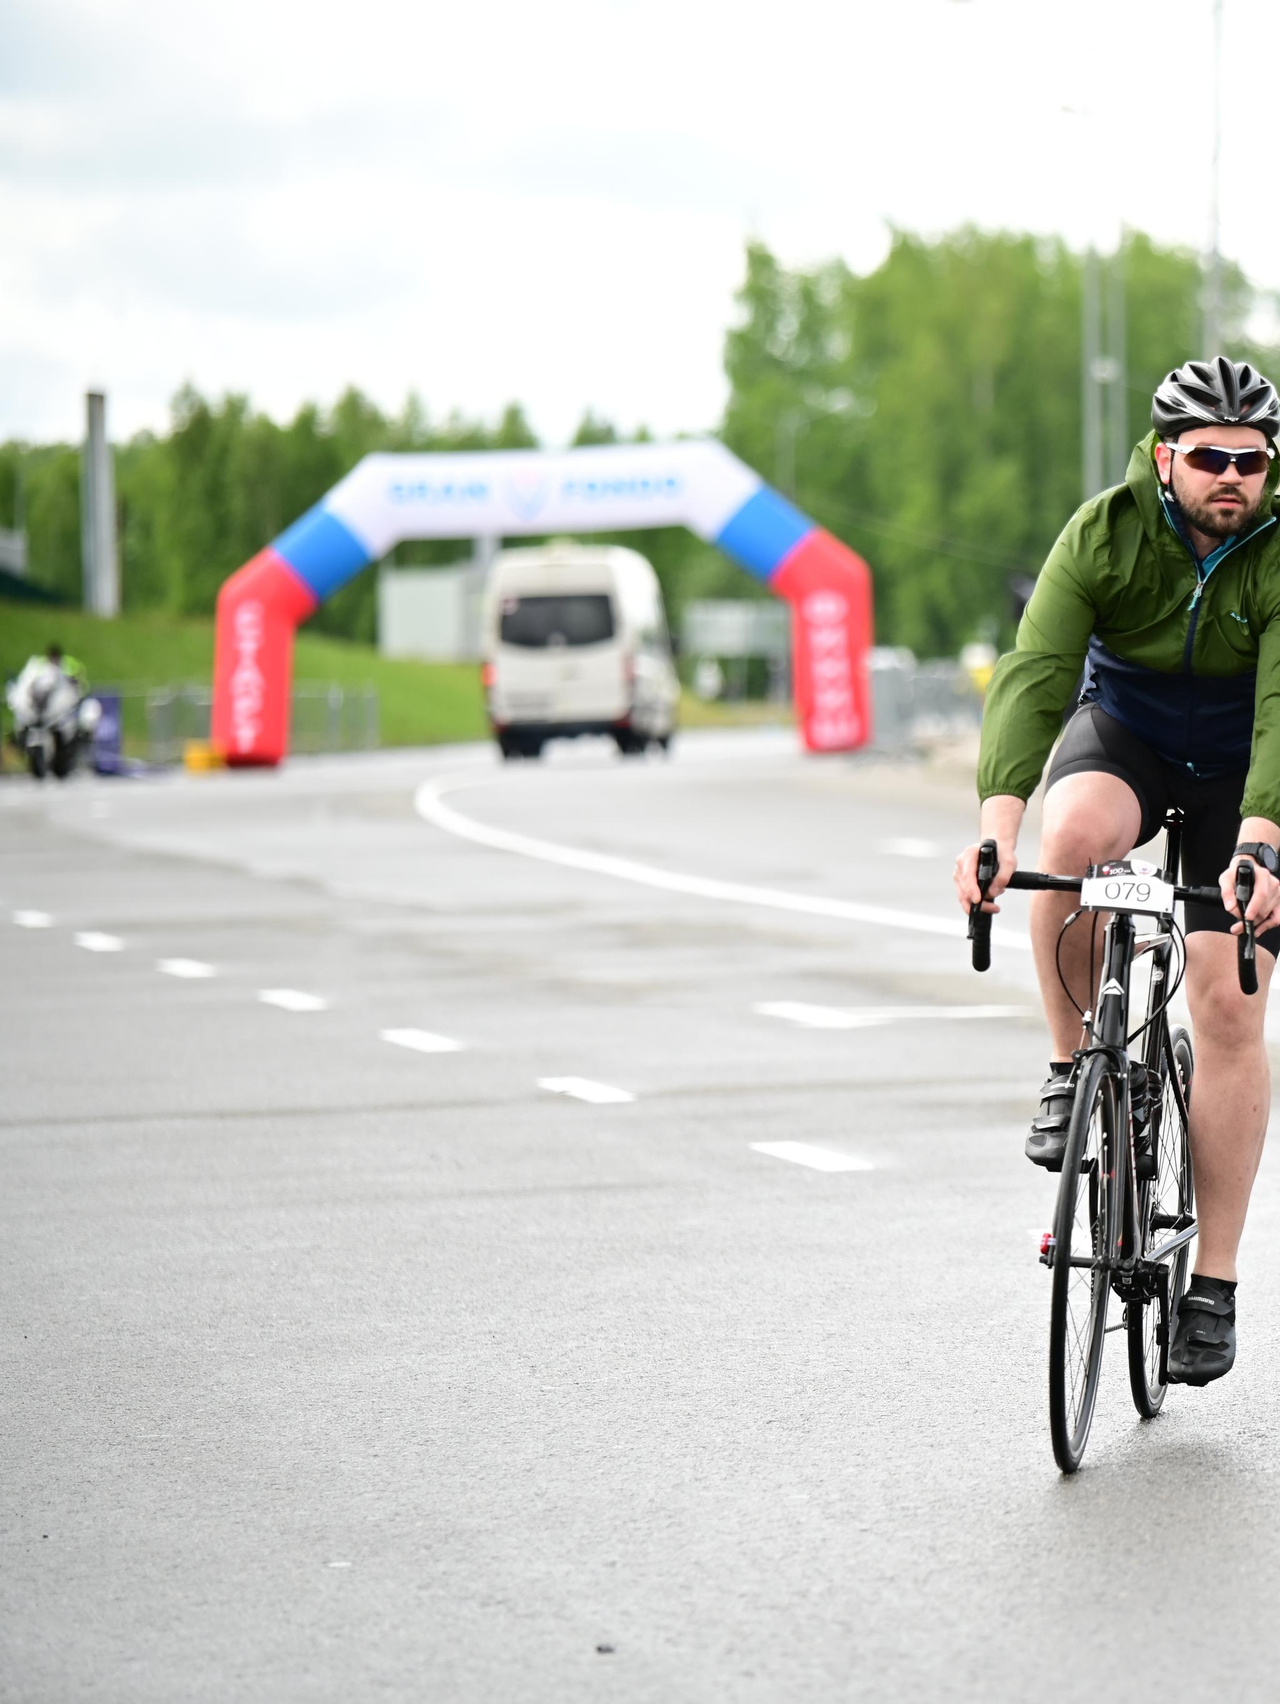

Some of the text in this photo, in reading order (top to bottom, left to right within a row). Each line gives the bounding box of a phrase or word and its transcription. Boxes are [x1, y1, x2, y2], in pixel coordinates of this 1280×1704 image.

[1109, 867, 1123, 875] 100
[1105, 882, 1151, 902] 079
[1187, 1296, 1215, 1305] SHIMANO
